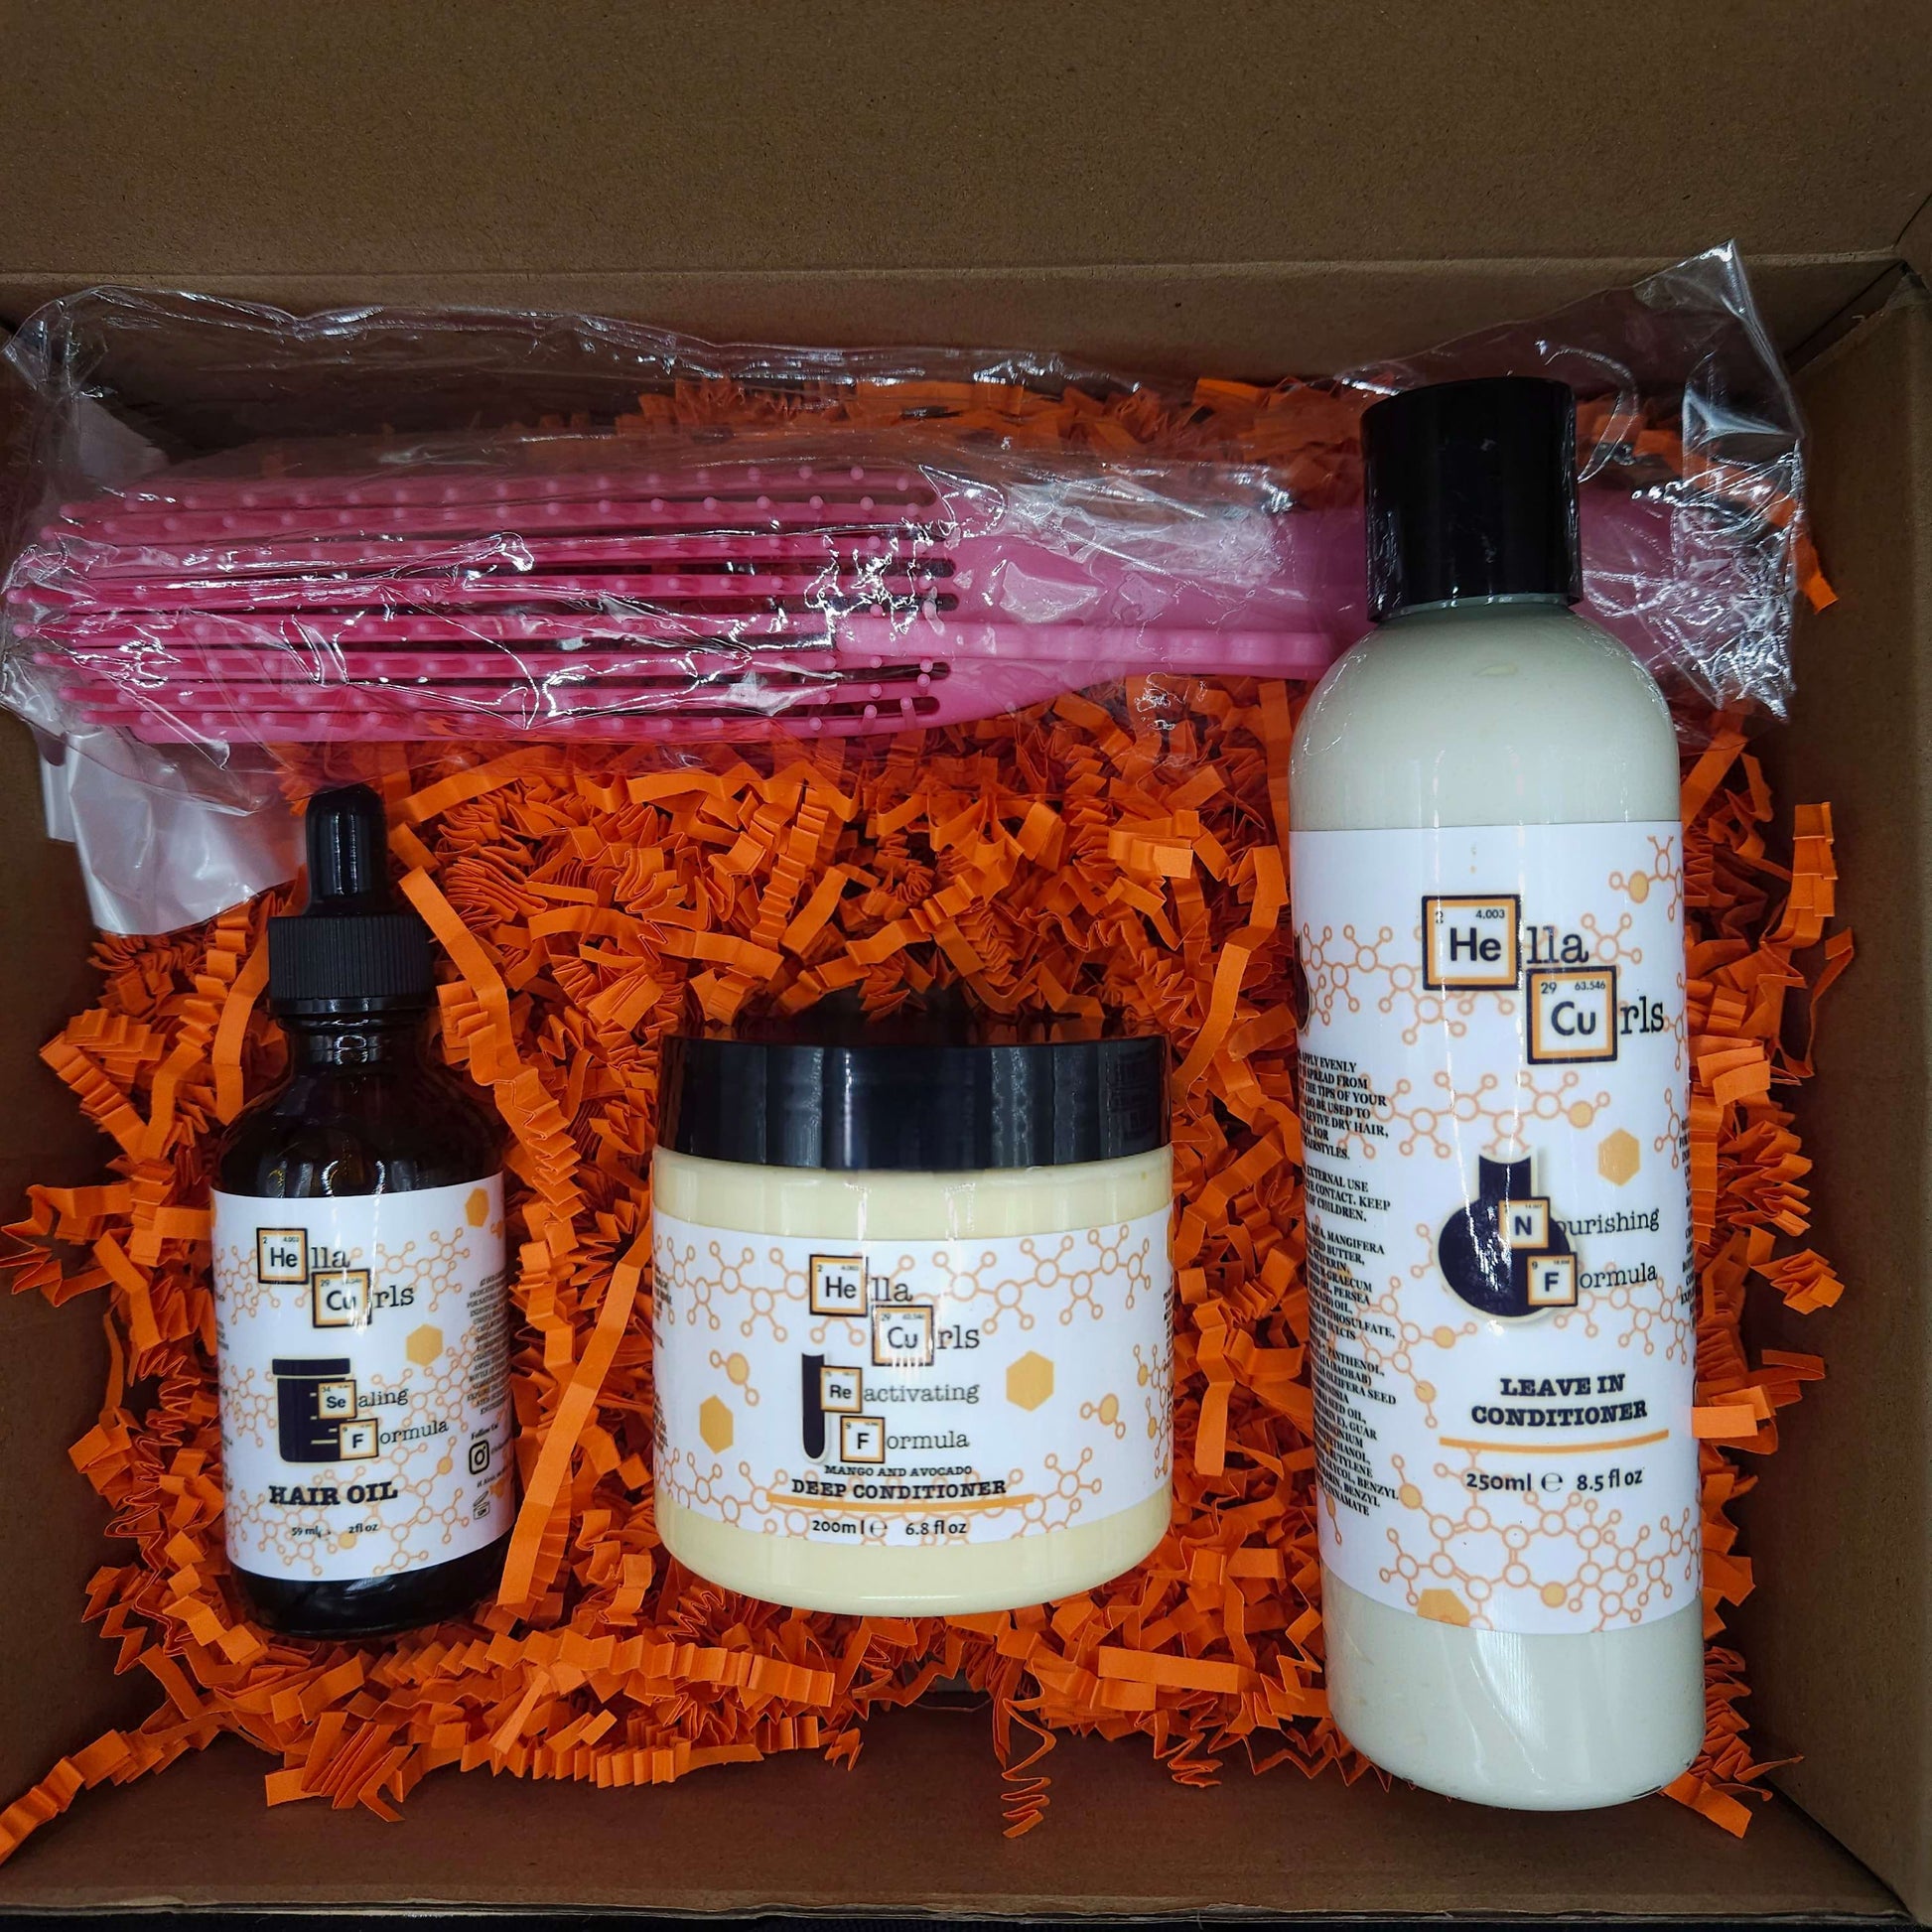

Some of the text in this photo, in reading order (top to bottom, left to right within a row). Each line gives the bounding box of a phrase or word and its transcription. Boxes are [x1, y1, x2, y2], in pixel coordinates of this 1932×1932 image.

[1476, 909, 1505, 919] 4.003
[1541, 981, 1606, 995] 29 63.546
[1319, 1056, 1357, 1073] EVENLY
[1336, 1074, 1368, 1090] FROM
[1317, 1084, 1336, 1100] TIPS
[1336, 1089, 1350, 1102] OF
[1352, 1091, 1388, 1107] YOUR
[1327, 1101, 1353, 1117] USED
[1354, 1106, 1371, 1120] TO
[1312, 1126, 1329, 1142] FOR
[1331, 1117, 1352, 1131] DRY
[1354, 1121, 1389, 1139] HAIR,
[1307, 1164, 1369, 1193] EXTERNAL USE
[1315, 1182, 1356, 1205] CONTACT.
[1359, 1195, 1391, 1211] KEEP
[1316, 1196, 1367, 1222] CHILDREN.
[1327, 1230, 1385, 1255] MANGIFERA
[1326, 1243, 1365, 1266] BUTTER,
[1333, 1285, 1371, 1307] PERSEA
[1334, 1300, 1353, 1314] OIL,
[1500, 1373, 1626, 1397] LEAVE IN
[1367, 1388, 1397, 1405] SEED
[1347, 1408, 1367, 1425] OIL,
[1470, 1399, 1648, 1428] CONDITIONER
[1349, 1421, 1378, 1441] GUAR
[824, 1464, 973, 1477] MANGO AND AVOCADO
[1466, 1472, 1532, 1491] 250ml
[1577, 1473, 1604, 1492] 8.5
[1608, 1467, 1620, 1489] fl
[1624, 1468, 1643, 1487] oz
[268, 1480, 399, 1506] HAIR OIL
[791, 1478, 1007, 1500] DEEP CONDITIONER
[1342, 1482, 1381, 1508] BENZYL
[1356, 1475, 1399, 1500] BENZYL
[291, 1527, 303, 1536] 59
[905, 1521, 929, 1535] 6.8
[933, 1520, 945, 1535] fl
[948, 1522, 968, 1535] oz
